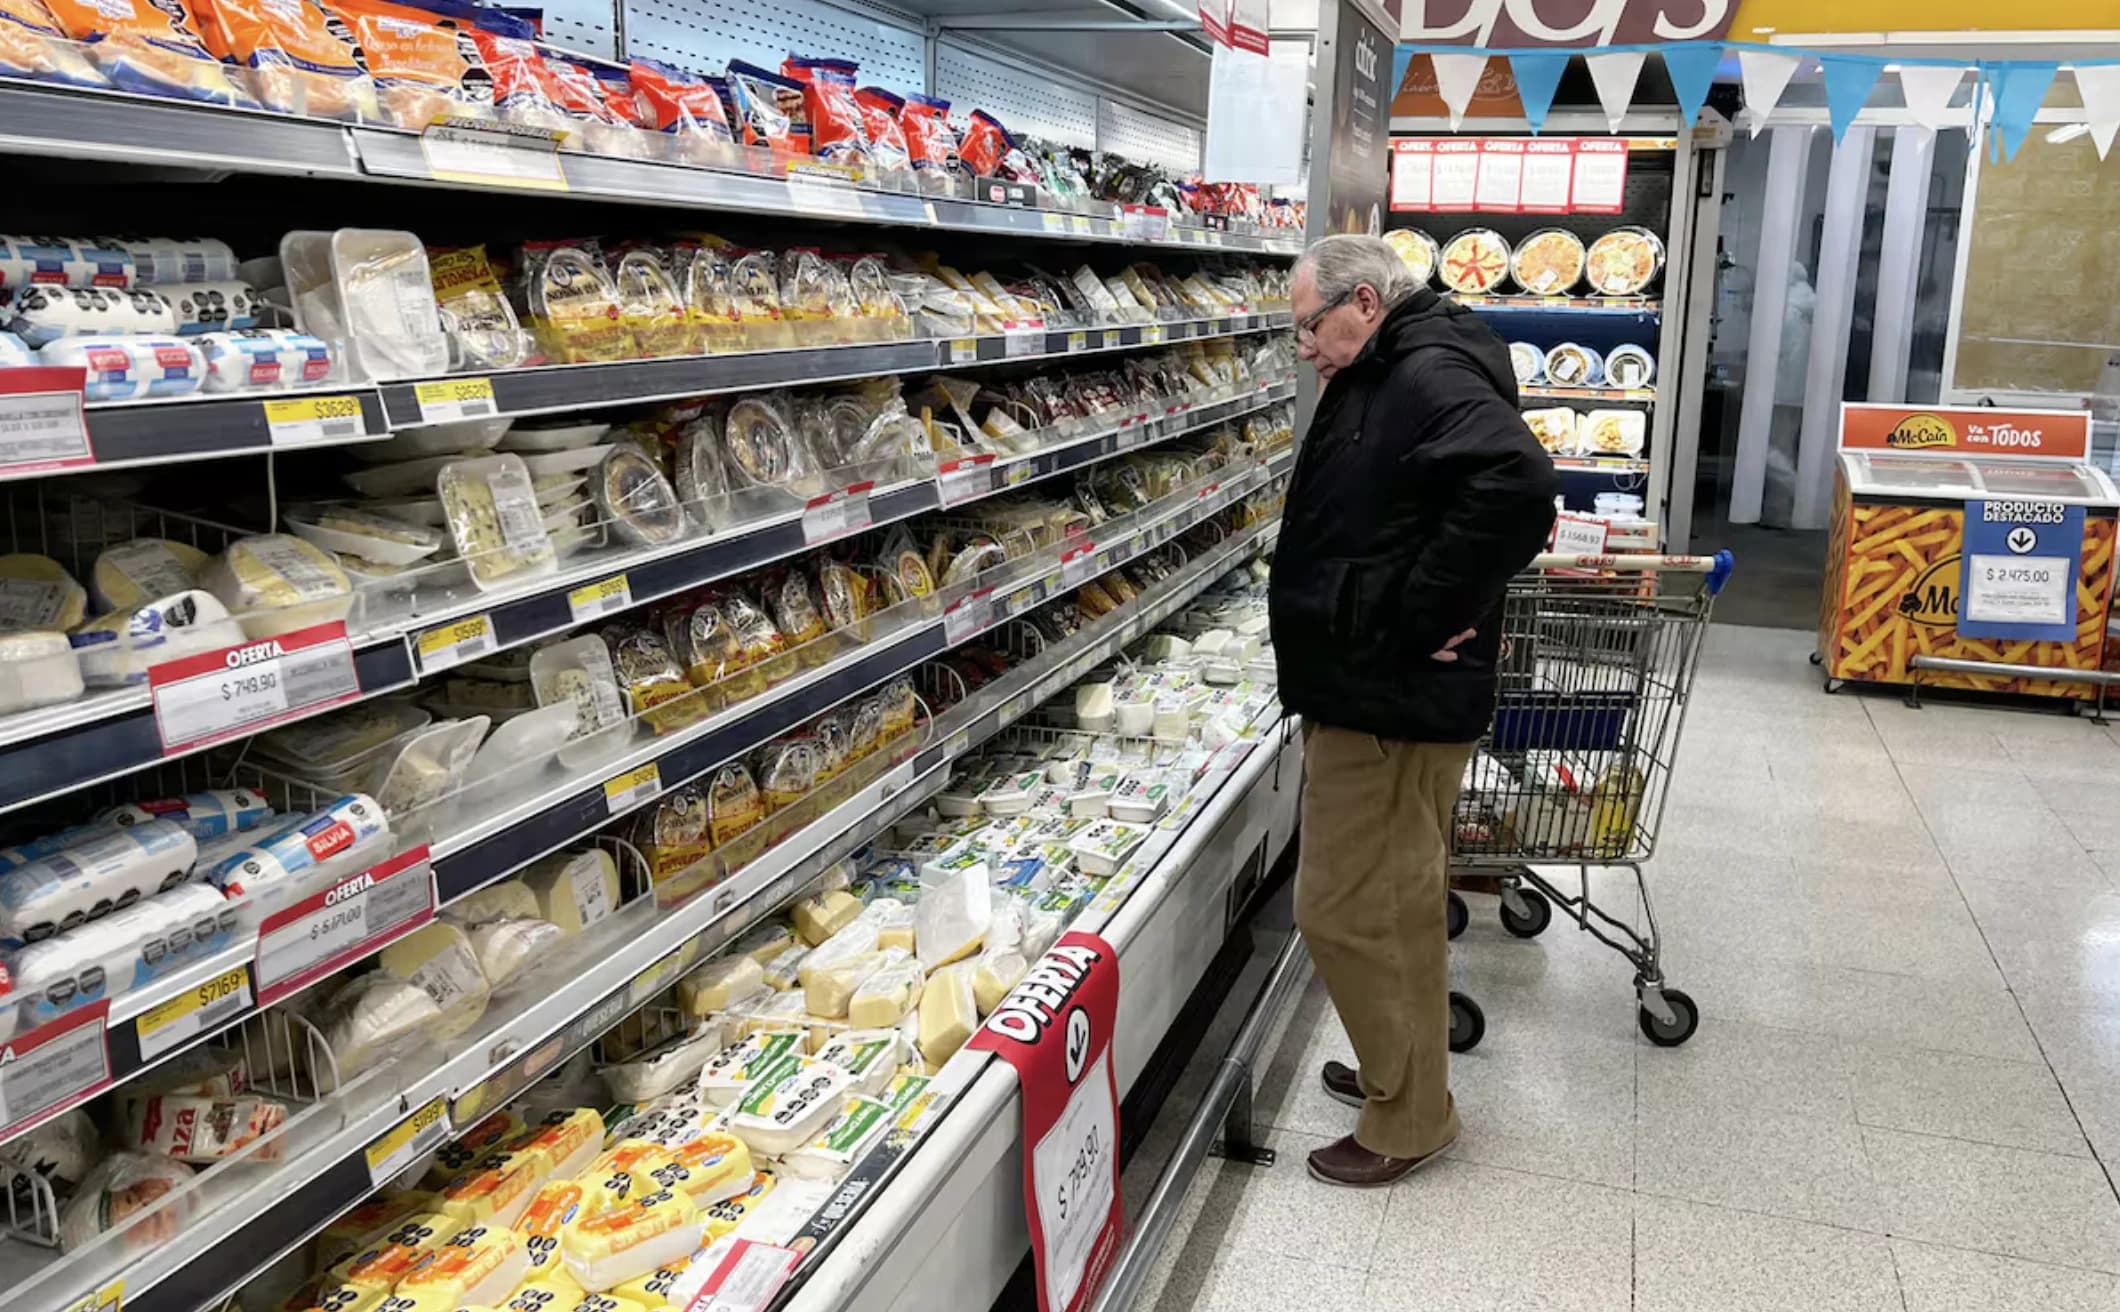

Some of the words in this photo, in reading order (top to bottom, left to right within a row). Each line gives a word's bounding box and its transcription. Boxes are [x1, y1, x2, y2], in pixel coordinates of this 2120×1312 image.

[1896, 425, 1948, 445] McCain
[1966, 434, 1989, 443] con
[1967, 424, 1985, 435] Va
[1983, 500, 2065, 514] PRODUCTO
[1983, 511, 2064, 524] DESTACADO
[226, 640, 285, 668] OFERTA
[310, 827, 352, 856] SILVIA
[323, 872, 374, 908] OFERTA
[986, 945, 1101, 1043] OFERTA
